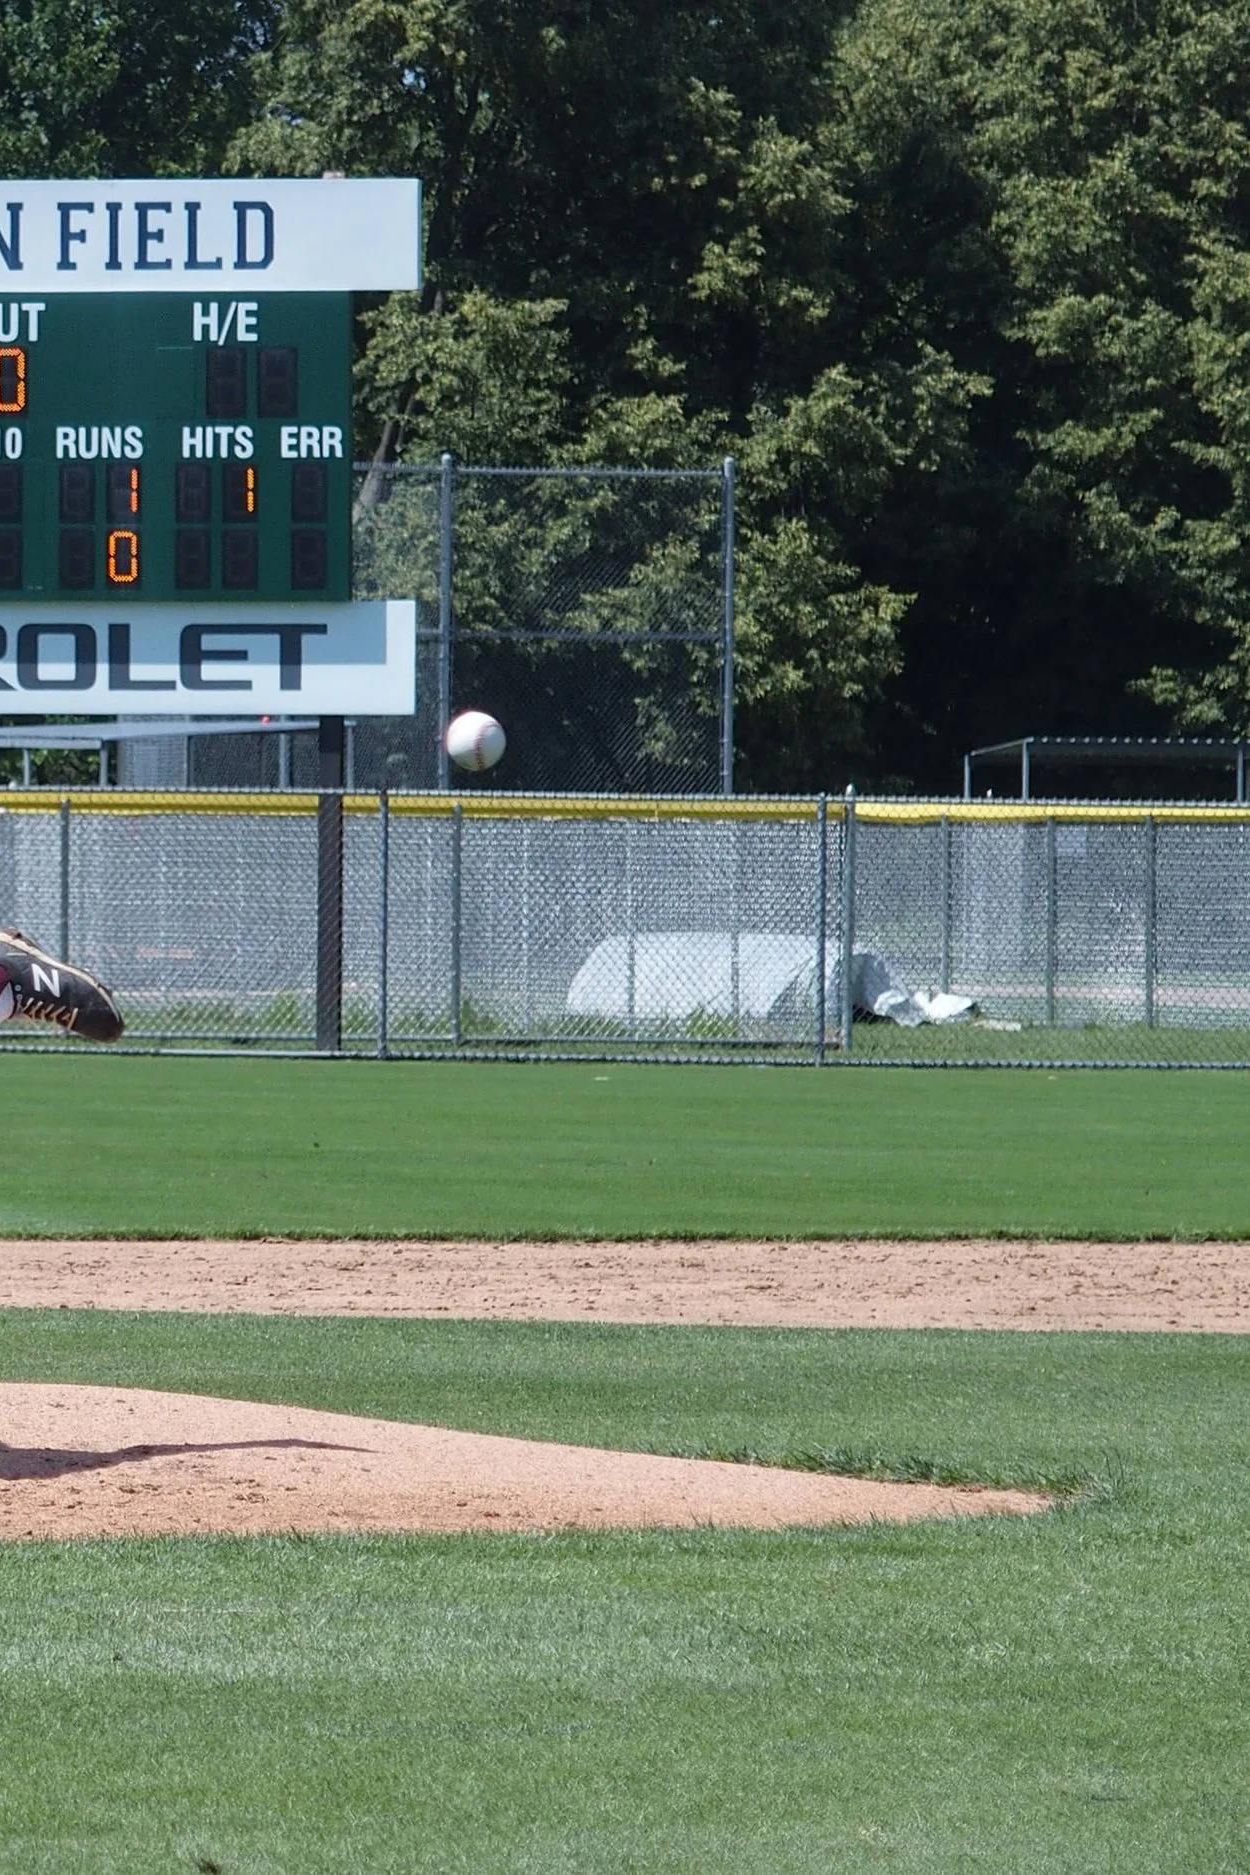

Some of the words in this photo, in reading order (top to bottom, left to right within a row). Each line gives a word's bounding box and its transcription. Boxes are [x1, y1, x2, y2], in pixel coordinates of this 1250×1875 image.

[56, 201, 276, 271] FIELD
[193, 301, 259, 346] H/E
[56, 425, 144, 459] RUNS
[182, 425, 255, 459] HITS
[280, 426, 343, 458] ERR
[130, 469, 139, 513] 1
[246, 468, 255, 513] 1
[108, 530, 138, 583] 0
[31, 963, 60, 998] N
